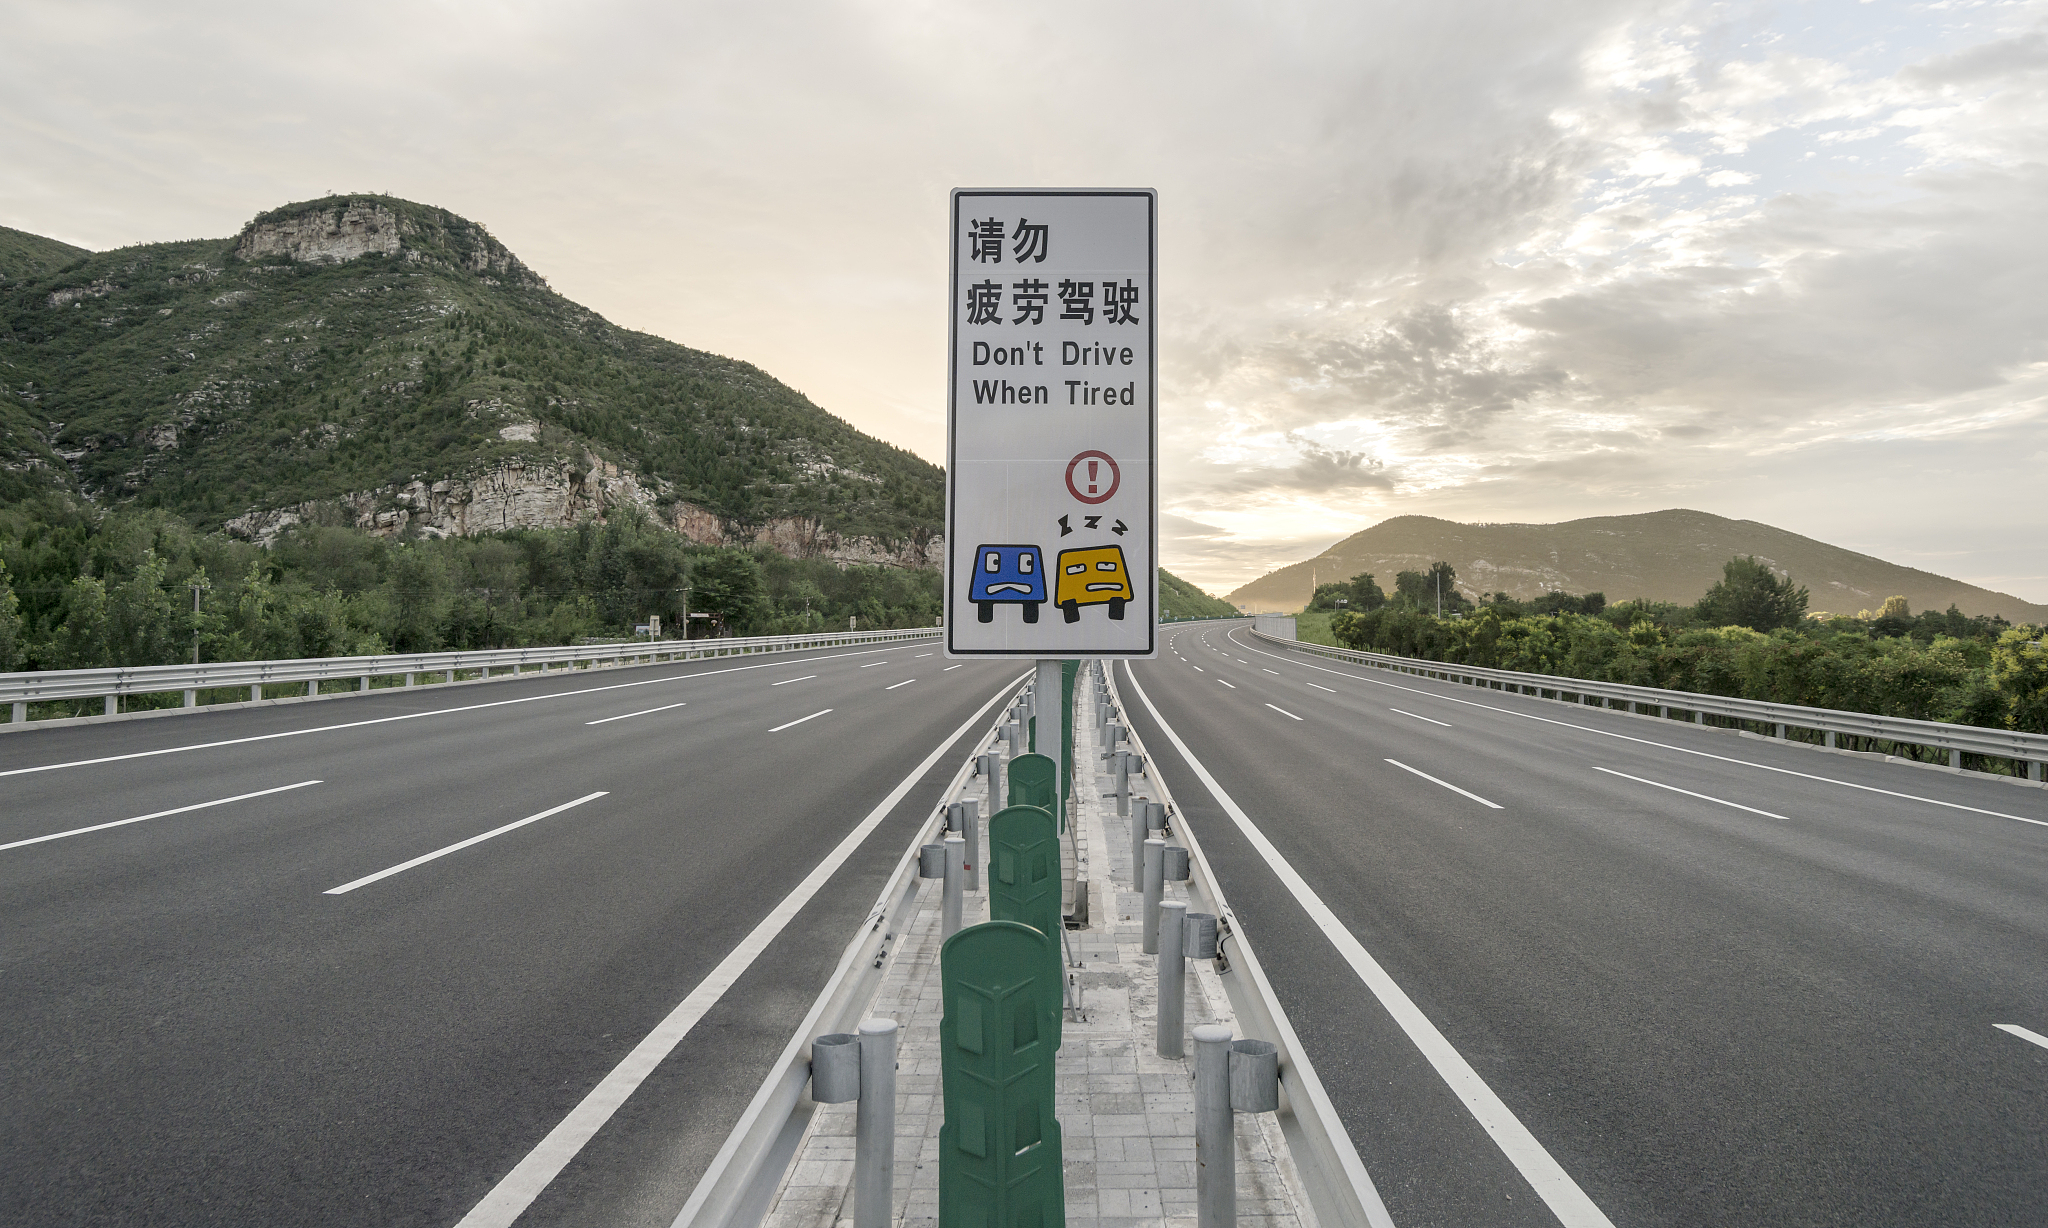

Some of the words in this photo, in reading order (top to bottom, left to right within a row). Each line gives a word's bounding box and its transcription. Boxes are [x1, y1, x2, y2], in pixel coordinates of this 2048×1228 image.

[967, 216, 1049, 264] 请勿
[966, 278, 1140, 326] 疲劳驾驶
[972, 340, 1044, 366] Don't
[1062, 340, 1134, 366] Drive
[972, 379, 1048, 405] When
[1064, 380, 1135, 406] Tired
